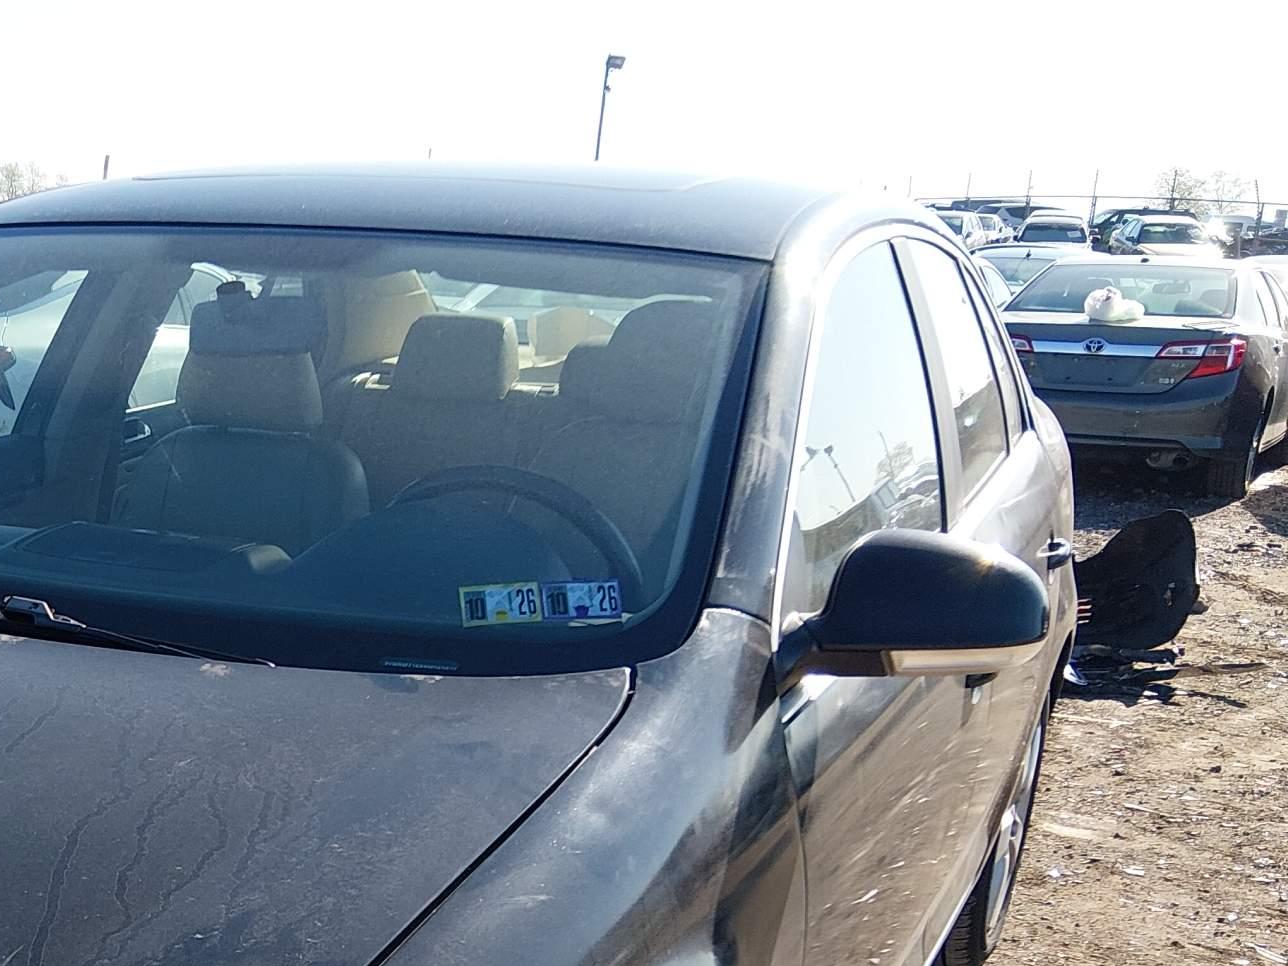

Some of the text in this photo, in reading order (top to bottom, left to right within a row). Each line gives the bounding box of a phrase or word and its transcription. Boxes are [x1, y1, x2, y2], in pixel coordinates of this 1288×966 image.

[465, 587, 537, 620] 10 26
[546, 584, 618, 616] 10 26
